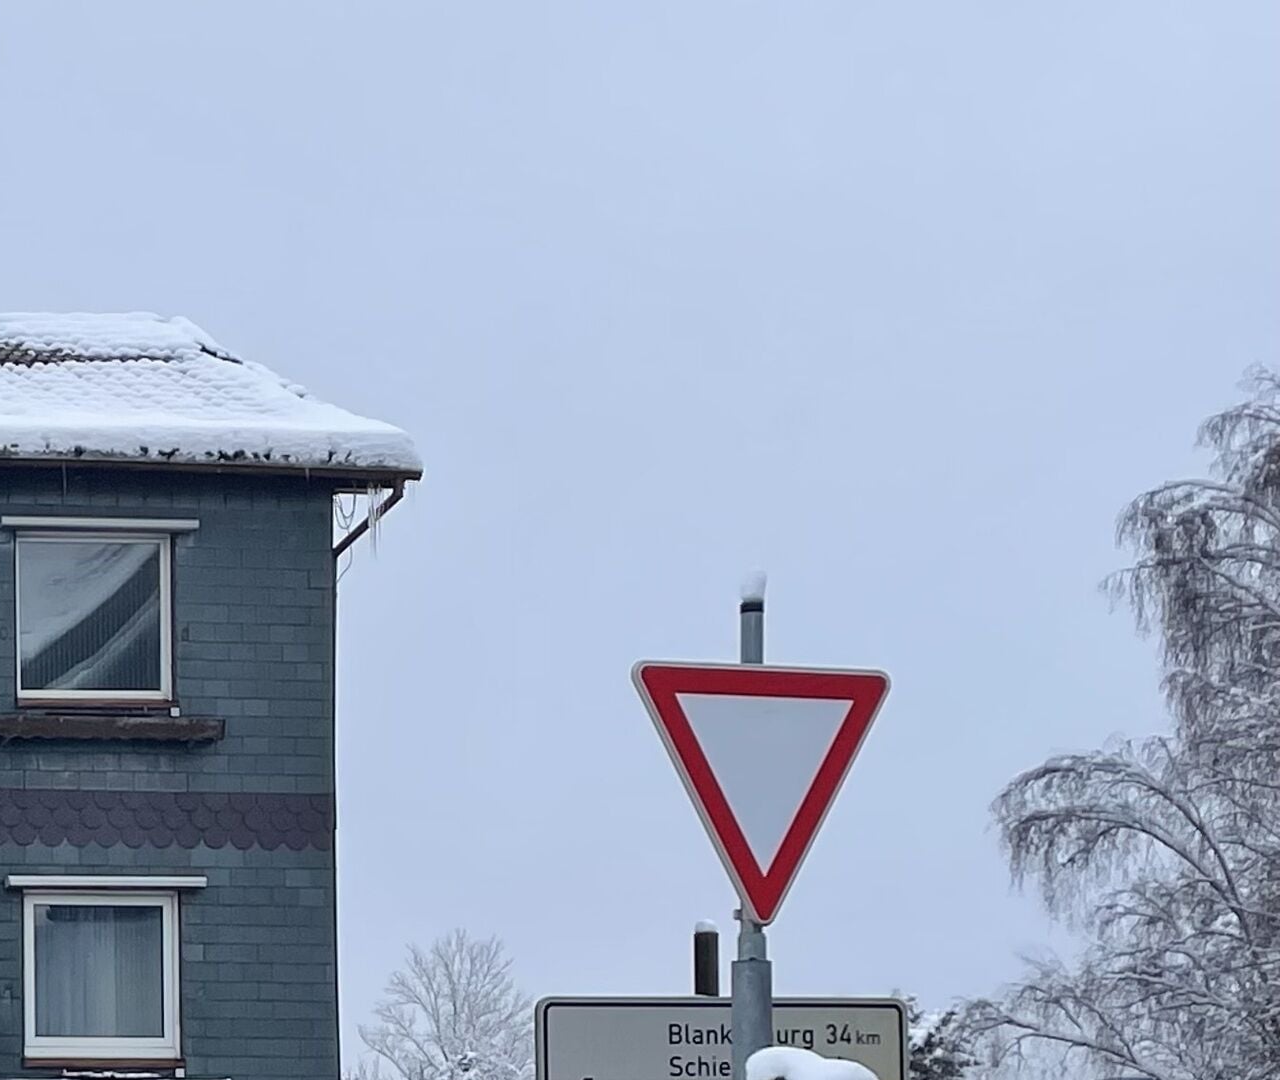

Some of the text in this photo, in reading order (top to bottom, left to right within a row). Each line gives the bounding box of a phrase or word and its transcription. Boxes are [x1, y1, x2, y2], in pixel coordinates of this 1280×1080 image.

[668, 1023, 881, 1049] Blankurg 34 km
[669, 1055, 732, 1077] Schie
